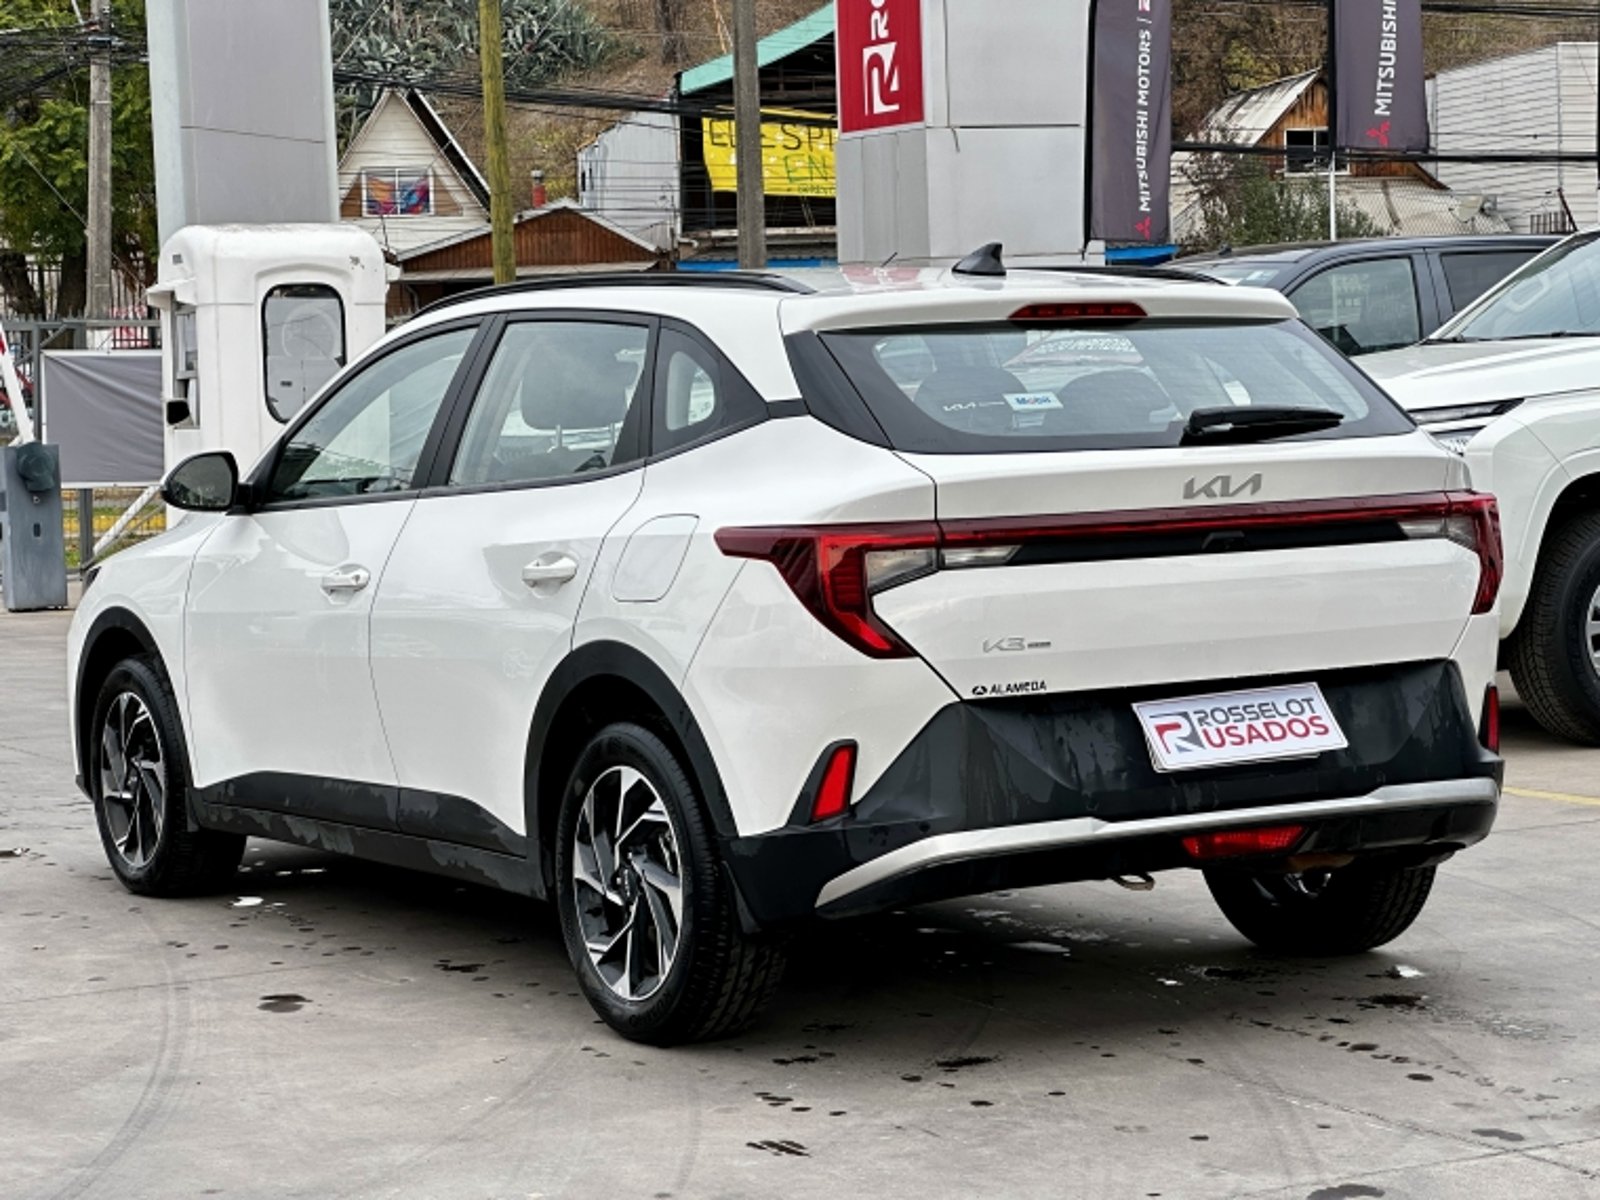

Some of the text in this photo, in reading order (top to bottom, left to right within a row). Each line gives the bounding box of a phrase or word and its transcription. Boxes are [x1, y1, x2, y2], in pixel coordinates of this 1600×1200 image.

[1137, 29, 1152, 106] MOTORS
[783, 153, 829, 183] EN
[1136, 110, 1152, 212] MITSUBISHI
[1183, 473, 1262, 499] KIA
[982, 637, 1025, 653] K3
[989, 679, 1048, 696] ALAMEDA
[1193, 697, 1319, 728] ROSSELOT
[1202, 715, 1330, 749] USADOS
